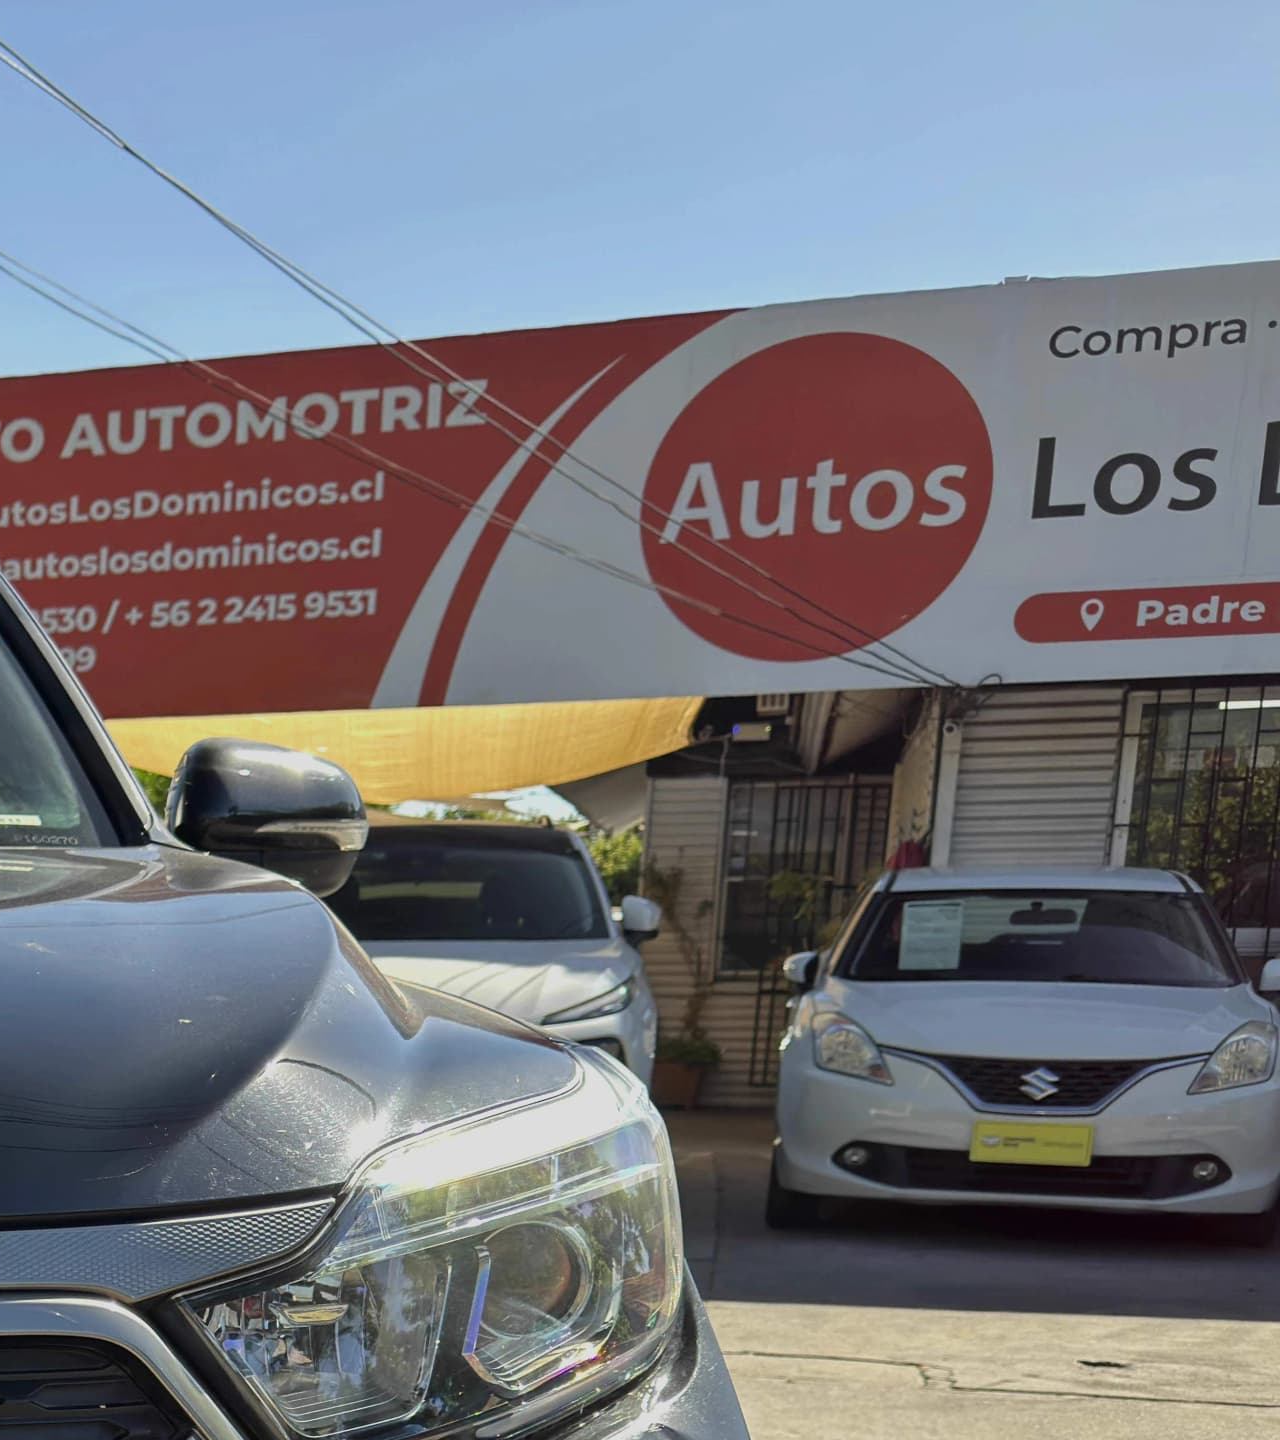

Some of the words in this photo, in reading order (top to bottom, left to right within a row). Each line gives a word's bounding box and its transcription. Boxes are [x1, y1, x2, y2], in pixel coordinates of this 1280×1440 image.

[1048, 318, 1249, 359] Compra
[60, 378, 489, 459] AUTOMOTRIZ
[659, 458, 968, 545] Autos
[1030, 436, 1219, 520] Los
[149, 599, 191, 629] 56
[197, 598, 219, 626] 2
[224, 592, 298, 624] 2415
[303, 588, 379, 620] 9531
[1135, 595, 1267, 629] Padre
